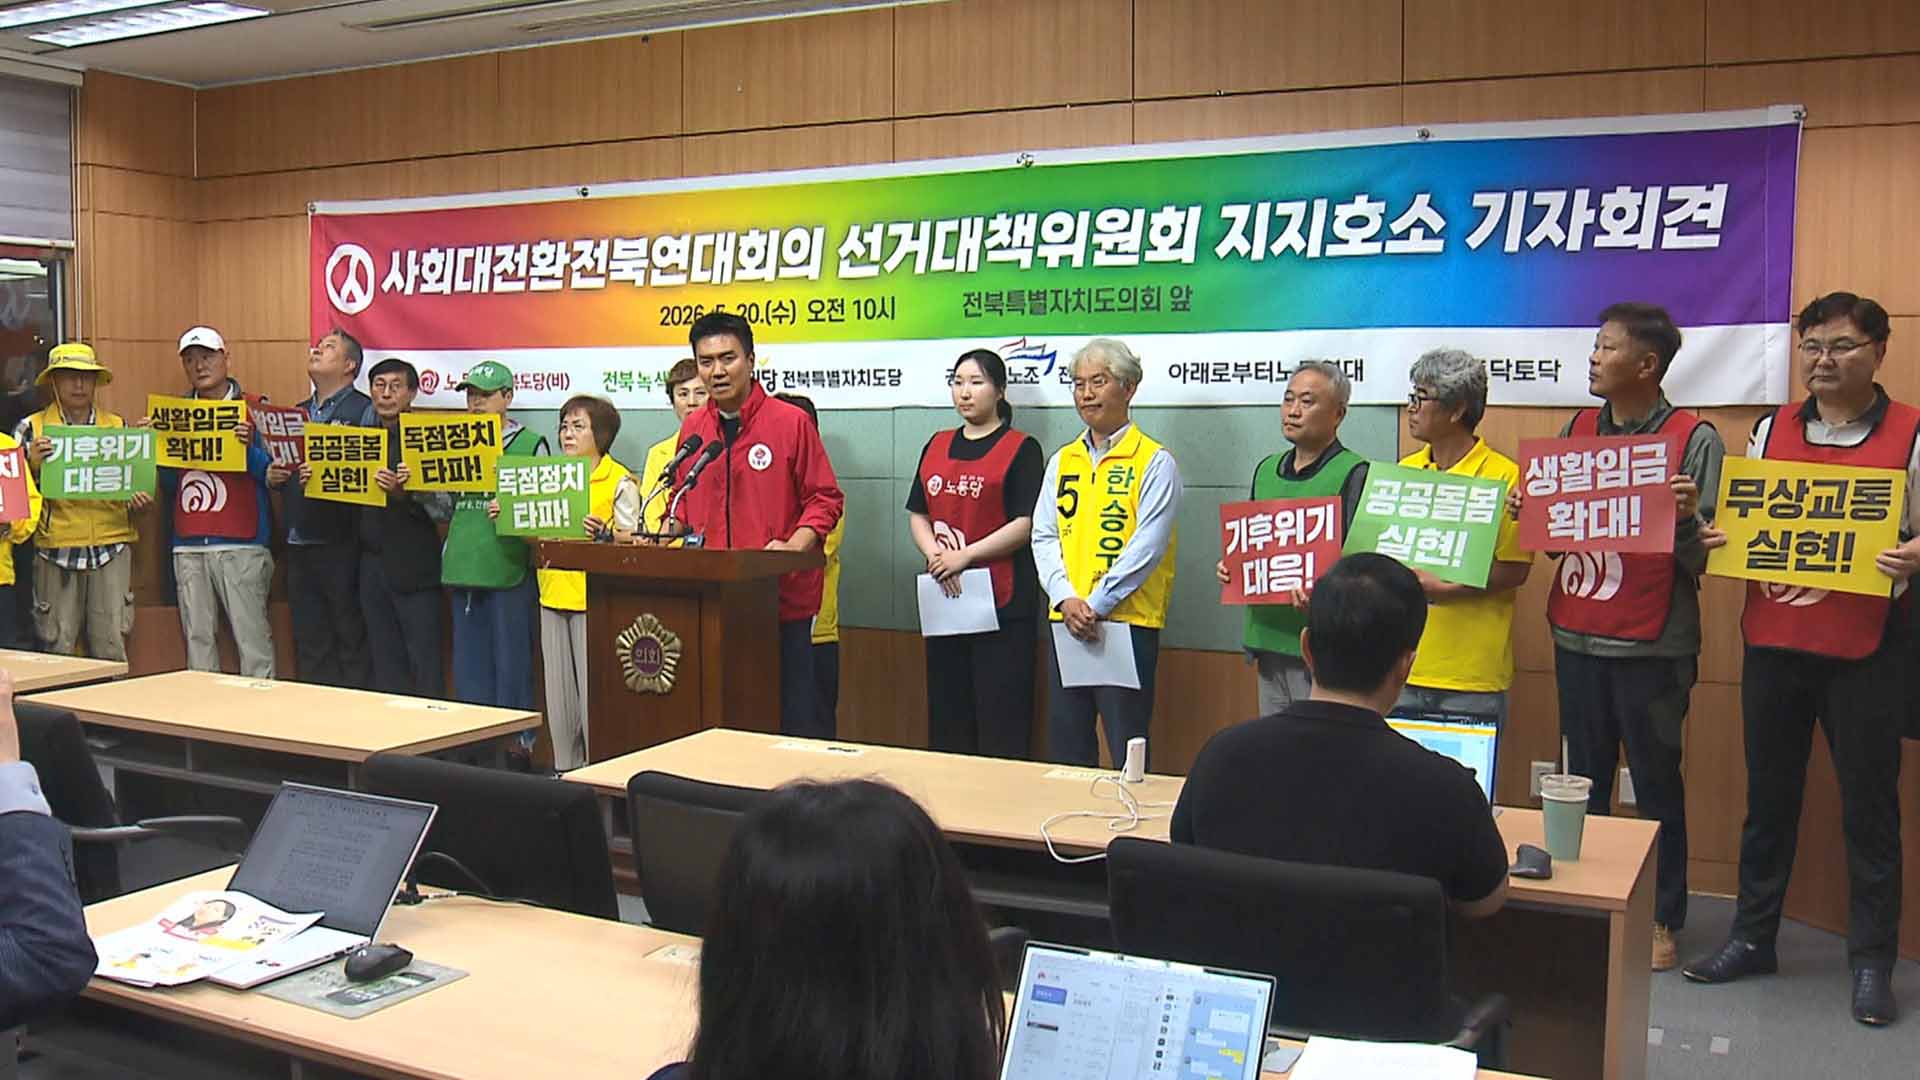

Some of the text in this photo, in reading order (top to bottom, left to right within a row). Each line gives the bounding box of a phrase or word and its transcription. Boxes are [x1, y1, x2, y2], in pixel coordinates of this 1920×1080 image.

[381, 182, 1729, 297] 사회대전환전북연대회의 선거대책위원회 지지호소 기자회견
[808, 297, 845, 323] 오전
[853, 296, 896, 321] 10시
[962, 284, 1193, 318] 전북특별자치도의회 앞
[782, 369, 903, 389] 전북특별자치도당
[1168, 358, 1364, 384] 아래로부터노대
[1482, 359, 1561, 382] 닥토닥
[151, 406, 241, 432] 생활임금
[47, 433, 151, 463] 기후위기
[166, 437, 223, 462] 확대!
[307, 434, 382, 462] 공공돌봄
[404, 420, 495, 453] 독점정치
[64, 464, 131, 493] 대응!
[321, 467, 368, 493] 실현!
[421, 455, 482, 484] 타파!
[499, 462, 584, 497] 독점정치
[1525, 442, 1668, 497] 생활임금
[513, 496, 570, 529] 타파!
[1056, 474, 1080, 519] 5
[1366, 479, 1499, 525] 공공돌봄
[1726, 478, 1893, 522] 무상교통
[1225, 503, 1336, 555] 기후위기
[1547, 495, 1641, 541] 확대!
[1376, 524, 1469, 568] 실현!
[1746, 529, 1856, 574] 실현!
[1242, 551, 1315, 596] 대응!
